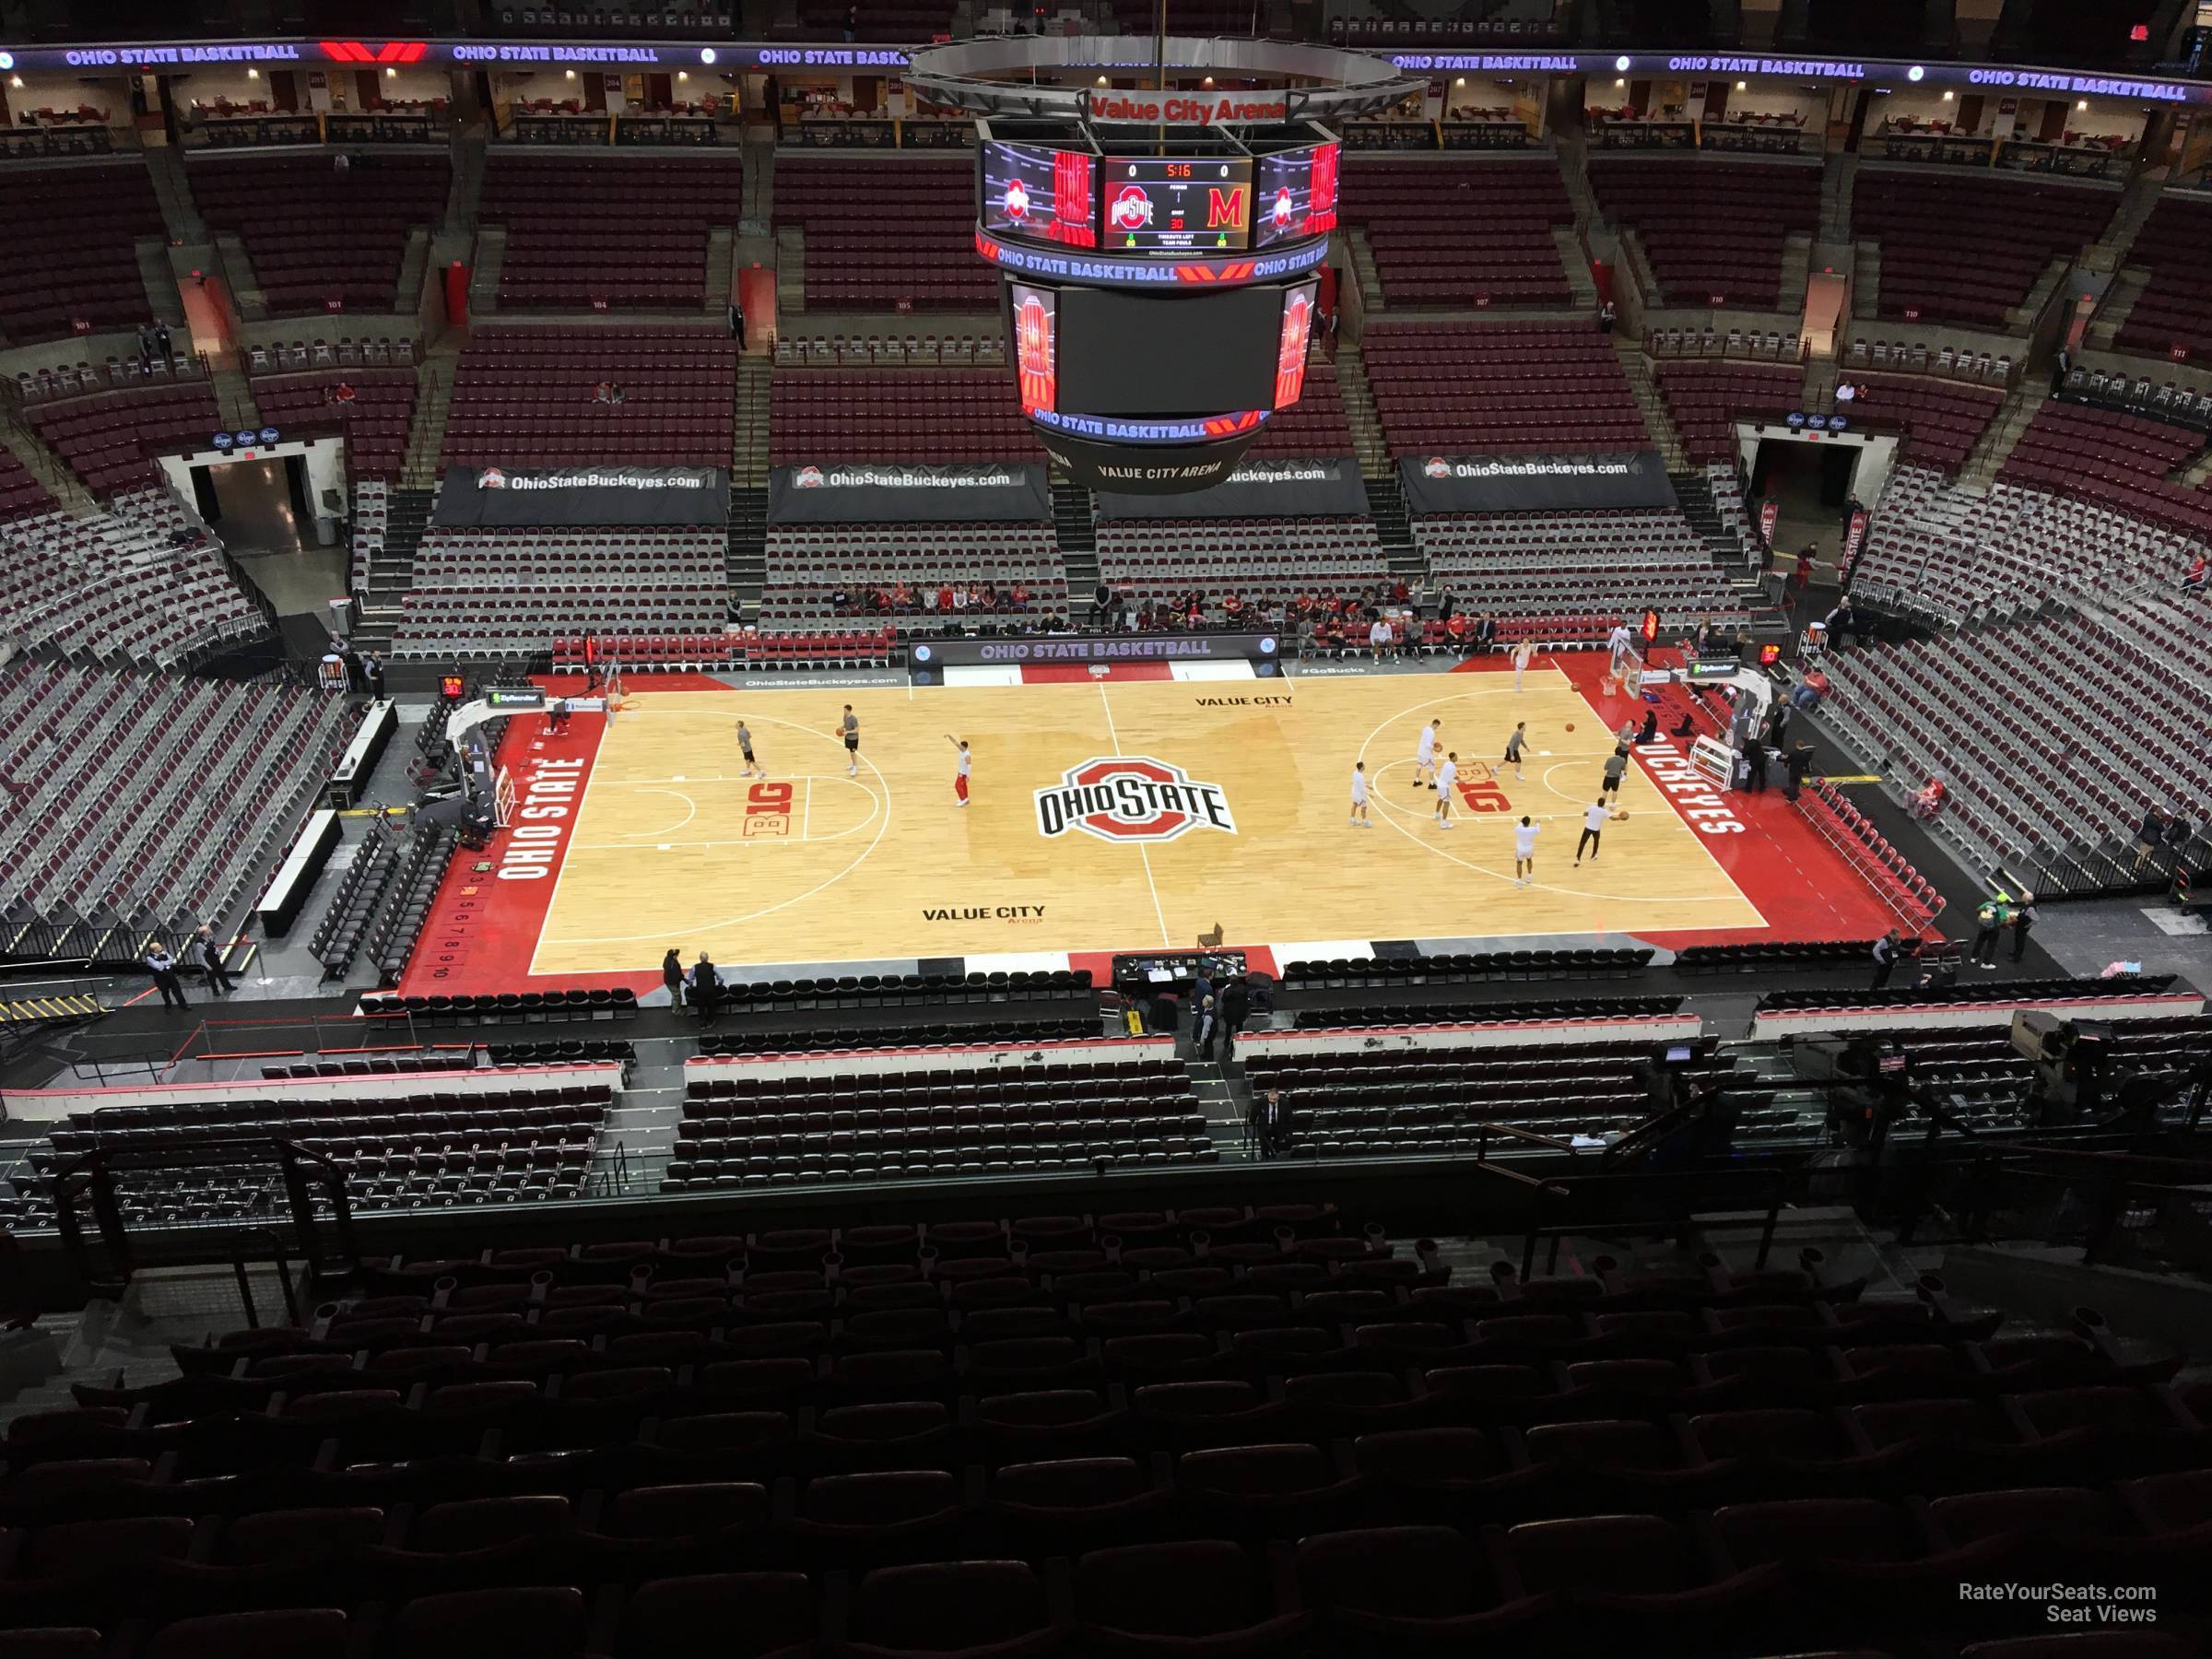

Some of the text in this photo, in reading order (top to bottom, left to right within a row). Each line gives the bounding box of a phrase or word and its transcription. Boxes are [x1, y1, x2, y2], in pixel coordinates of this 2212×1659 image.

[66, 45, 299, 65] OHIO STATE BASKETBALL
[453, 46, 658, 62] OHIO STATE BASKETBALL
[759, 50, 801, 64] OHIO
[804, 51, 852, 65] STATE
[1393, 56, 1577, 69] OHIO STATE BASKETBALL
[1669, 57, 1865, 77] OHIO STATE BASKETBALL
[1970, 70, 2186, 100] OHIO STATE BASKETBALL
[1090, 97, 1286, 125] Value City Arena
[1128, 164, 1137, 177] 0
[1167, 164, 1191, 177] 5:16
[1220, 164, 1229, 177] 0
[1206, 188, 1244, 228] M
[1171, 218, 1183, 229] 30
[997, 248, 1178, 281] OHIO STATE BASKETBALL
[1253, 261, 1286, 276] OHIO
[1288, 250, 1315, 270] STATE
[1034, 408, 1206, 438] OHIO STATE BASKETBALL
[1098, 461, 1222, 479] VALUE CITY ARENA
[1456, 463, 1628, 478] OhioStateBuckeyes.com
[512, 474, 700, 489] OhioStateBuckeyes.com
[830, 471, 1010, 488] OhioStateBuckeyes.com
[981, 641, 1211, 659] OHIO STATE BASKETBALL
[746, 677, 898, 687] OhioStateBuckeyes.com
[1195, 696, 1292, 707] VALUE CITY
[1633, 732, 1746, 833] UCKEYES
[1040, 779, 1231, 835] OHIO STATE
[497, 758, 584, 880] OHIO STATE
[923, 906, 1045, 921] VALUE CITY
[433, 967, 450, 978] 10
